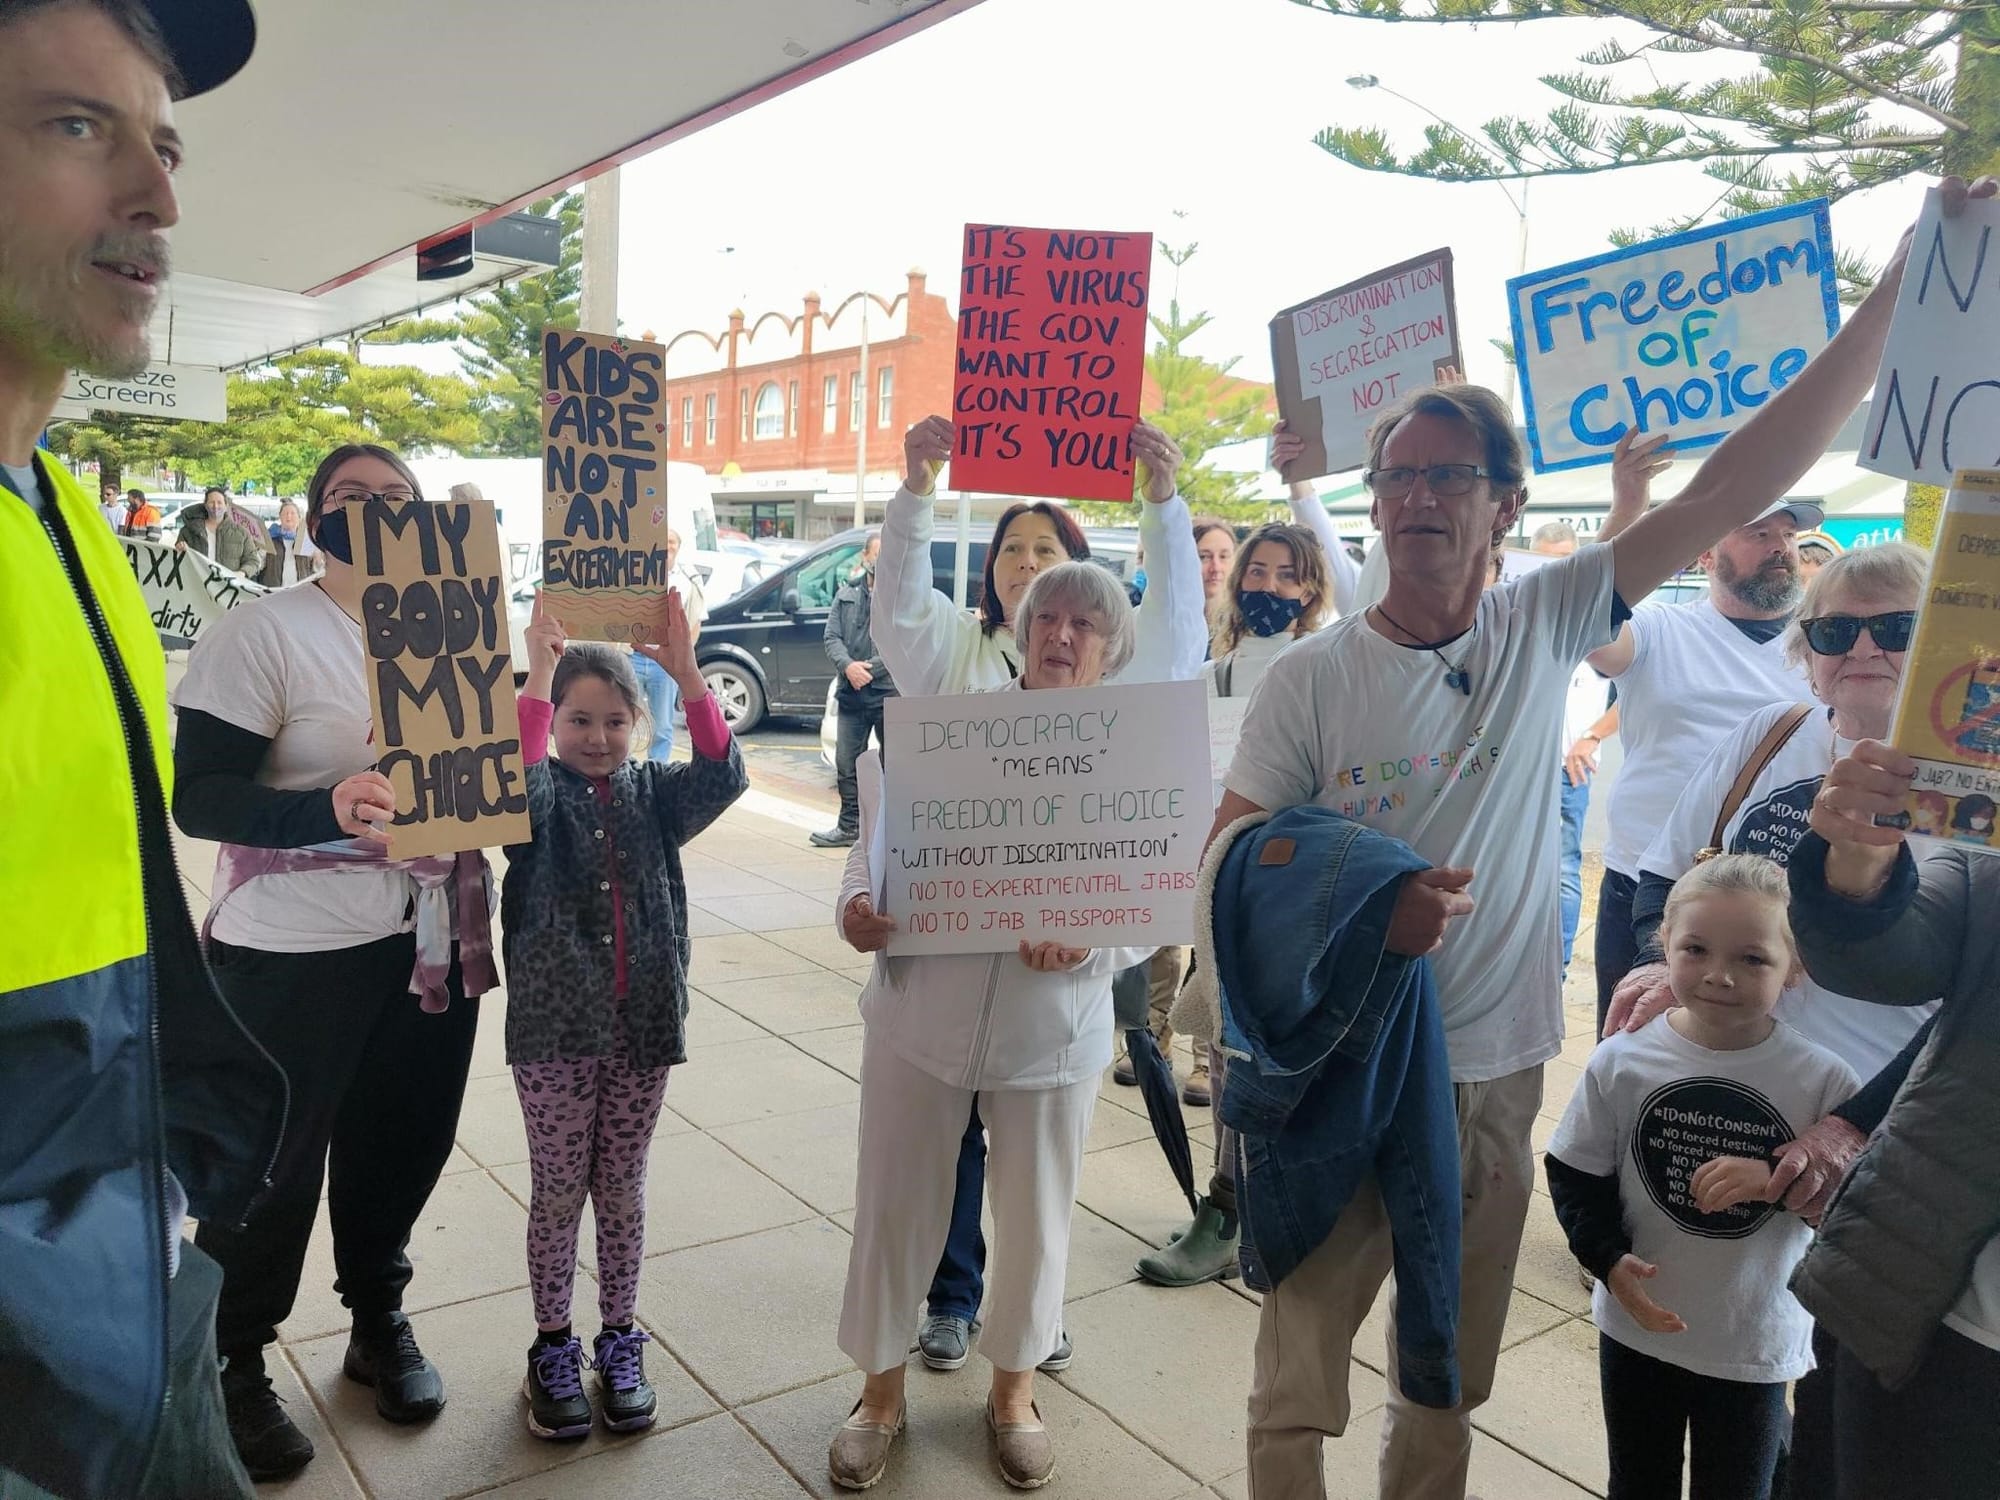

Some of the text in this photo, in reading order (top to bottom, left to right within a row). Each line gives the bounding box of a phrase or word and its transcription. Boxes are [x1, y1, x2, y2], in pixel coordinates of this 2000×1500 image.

[968, 225, 1130, 261] IT'S NOT
[1918, 221, 1997, 312] N
[962, 264, 1145, 308] THE VIRUS
[1297, 260, 1443, 336] DISCRIMINATION
[1531, 239, 1820, 354] Freedom
[959, 306, 1125, 346] THE GOV.
[545, 332, 662, 404] KIDS
[958, 348, 1115, 380] WANT TO
[78, 379, 176, 407] Screens
[956, 384, 1132, 421] CONTROL
[1353, 372, 1400, 413] NOT
[1569, 348, 1808, 446] Choice
[548, 395, 655, 451] ARE
[960, 422, 1132, 476] IT'S YOU!
[546, 445, 657, 509] NOT
[564, 492, 630, 544] AN
[363, 501, 470, 577] MY
[543, 540, 669, 589] EXPERIMENT
[151, 600, 201, 637] dirty
[361, 576, 499, 660] BODY
[377, 654, 511, 747] MY
[919, 710, 1118, 753] DEMOCRACY
[992, 749, 1107, 778] "MEANS"
[911, 789, 1184, 832] FREEDOM OF CHOICE
[1343, 791, 1405, 817] HUMAN
[1748, 829, 1795, 853] NO forc
[1769, 823, 1788, 837] NO
[891, 833, 1178, 869] "WITHOUT DISCRIMINATION"
[1769, 848, 1788, 862] NO
[909, 872, 1196, 901] NO TO EXPERIMENTAL JABS
[909, 908, 1152, 934] NO TO JAB PASSPORTS
[1649, 1136, 1665, 1149] NO
[1668, 1140, 1703, 1157] forced
[1663, 1127, 1680, 1139] NO
[1682, 1130, 1719, 1146] forced
[1666, 1167, 1683, 1179] NO
[1672, 1155, 1689, 1168] NO
[1668, 1192, 1685, 1205] NO
[1669, 1180, 1686, 1192] NO
